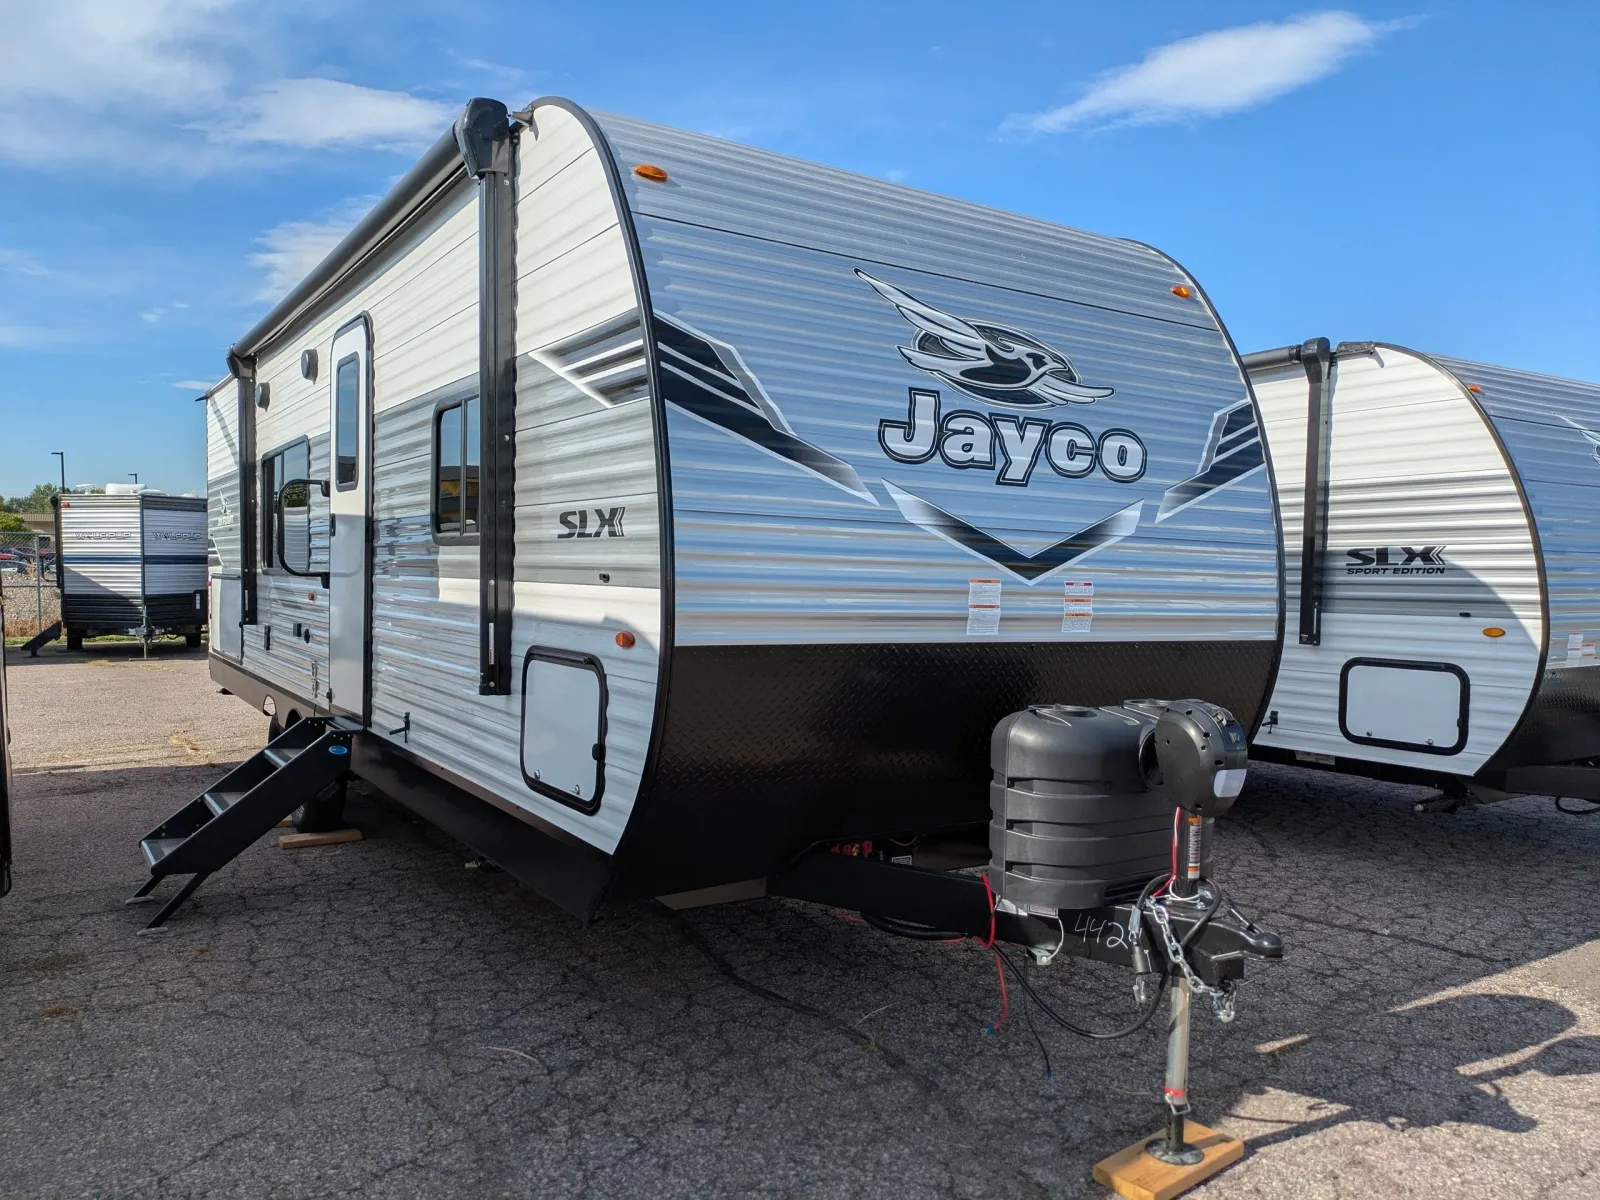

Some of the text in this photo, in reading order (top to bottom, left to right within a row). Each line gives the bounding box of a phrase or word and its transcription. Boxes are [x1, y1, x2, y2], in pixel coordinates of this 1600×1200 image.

[878, 387, 1148, 487] Jayco
[557, 507, 626, 539] SLX
[1346, 546, 1447, 566] SLX
[1393, 567, 1446, 575] EDITION
